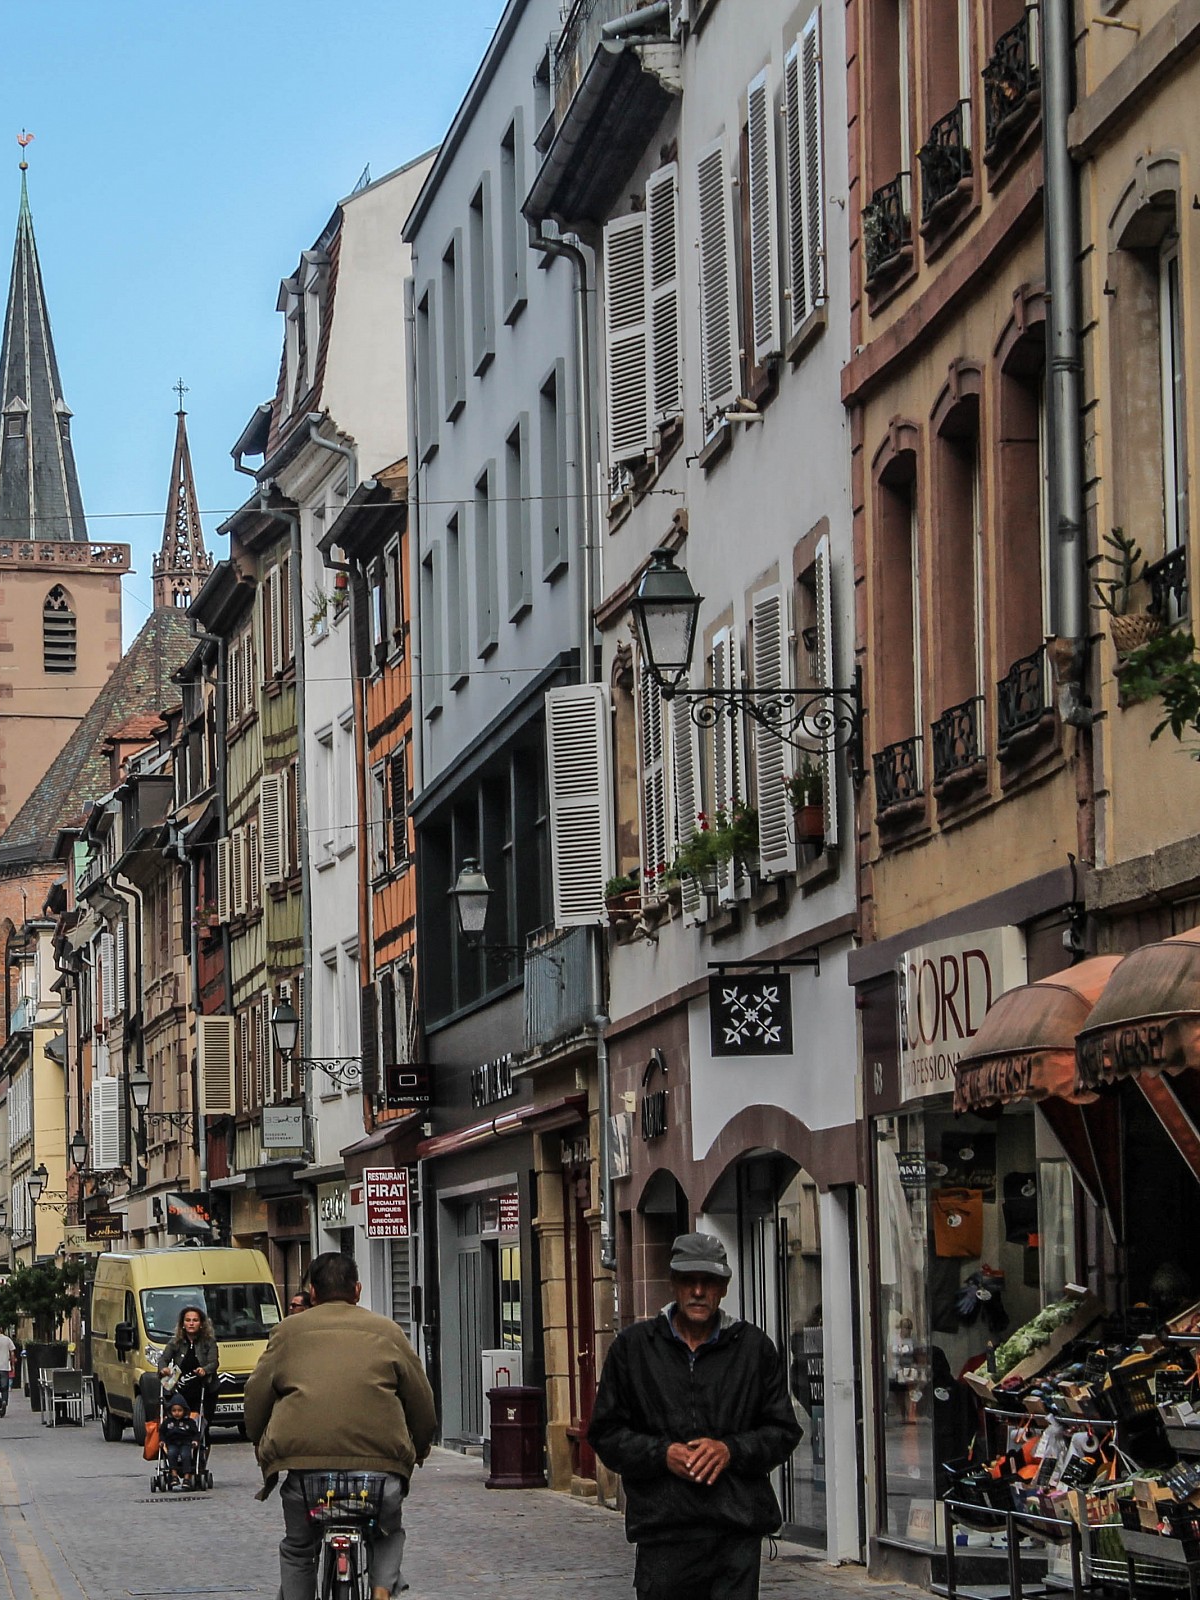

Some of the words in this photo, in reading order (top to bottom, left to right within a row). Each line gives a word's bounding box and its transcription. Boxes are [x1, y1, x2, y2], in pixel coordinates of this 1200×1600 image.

[367, 1172, 406, 1181] RESTAURANT
[367, 1184, 406, 1198] FIRAT
[168, 1204, 204, 1215] Speak
[189, 1213, 210, 1221] Out
[369, 1226, 376, 1235] 03
[377, 1226, 384, 1235] 88
[385, 1226, 391, 1235] 21
[392, 1226, 399, 1235] 81
